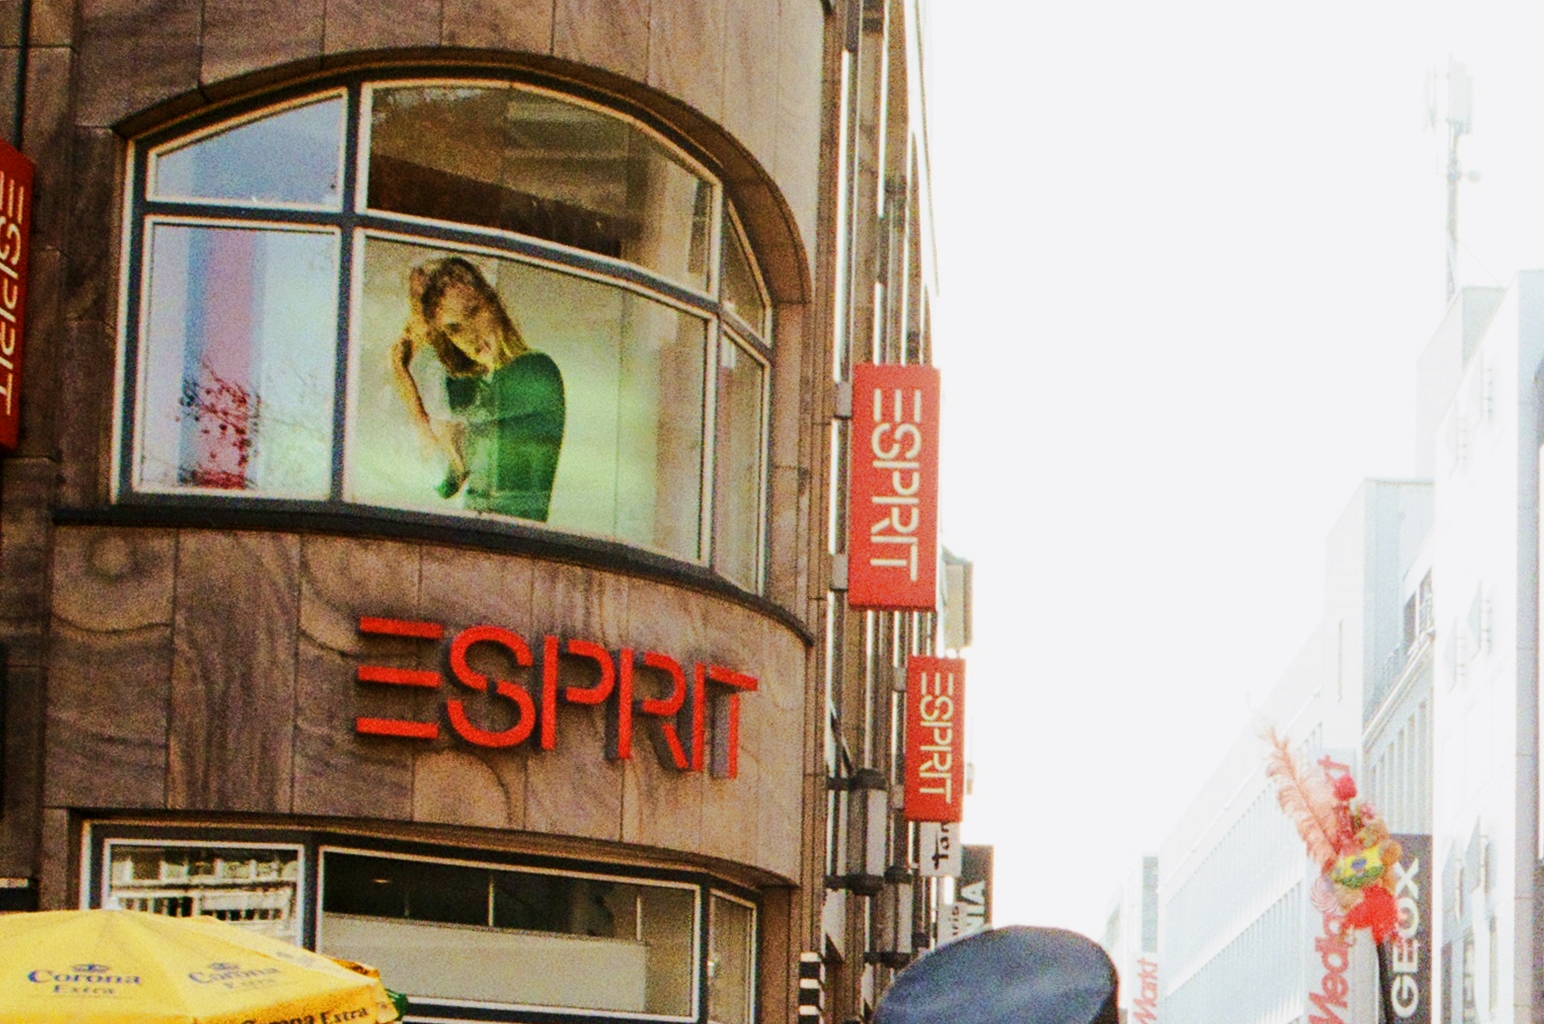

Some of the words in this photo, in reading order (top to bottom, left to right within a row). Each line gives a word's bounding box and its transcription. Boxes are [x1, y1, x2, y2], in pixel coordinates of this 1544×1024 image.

[869, 387, 922, 583] ESPRIT
[356, 615, 759, 780] ESPRIT
[918, 671, 955, 805] ESPRIT
[27, 968, 142, 985] Corona
[188, 965, 283, 986] Corona
[1391, 857, 1420, 1019] GEOX
